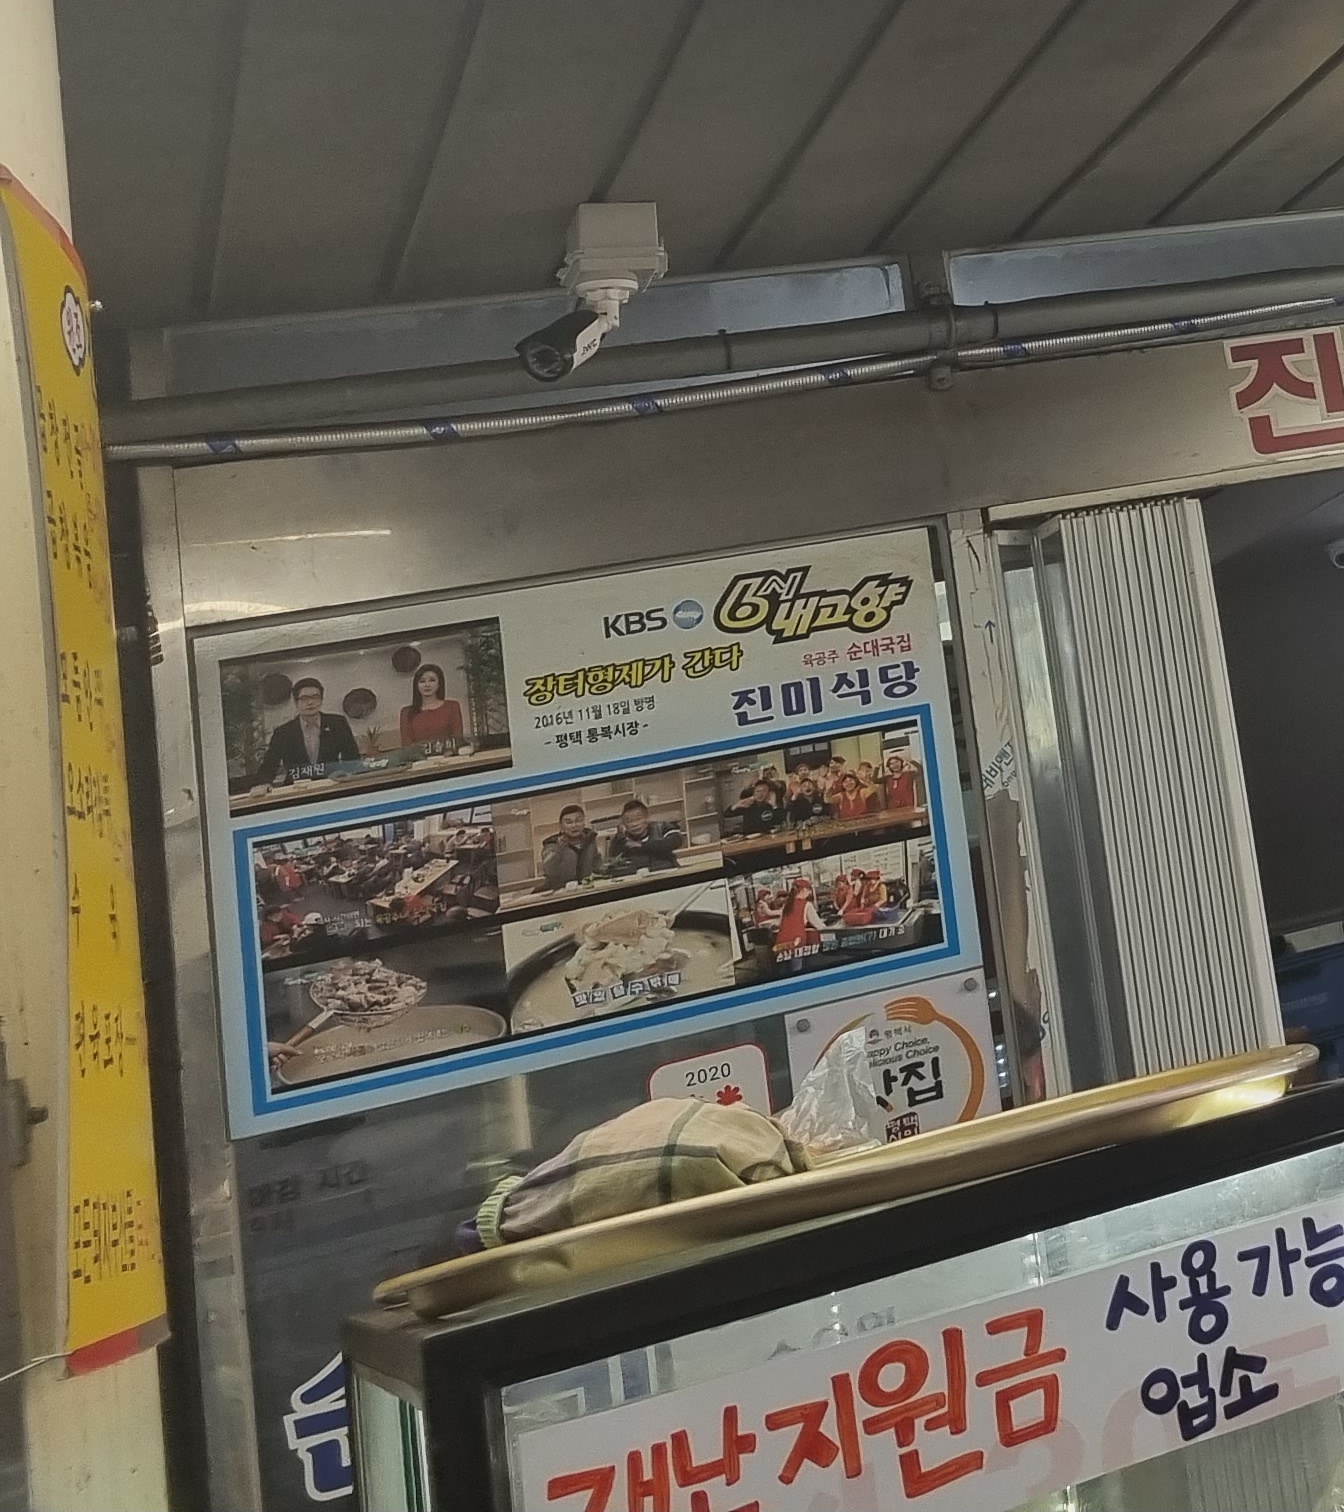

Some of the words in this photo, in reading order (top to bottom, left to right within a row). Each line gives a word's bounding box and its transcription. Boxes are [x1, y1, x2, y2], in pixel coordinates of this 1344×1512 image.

[603, 607, 668, 638] KBS
[713, 566, 810, 634] 6시
[768, 573, 914, 644] 내고향
[801, 648, 839, 668] 육공주
[846, 633, 913, 662] 순대국집
[524, 649, 675, 707] 장터형제가
[682, 641, 744, 679] 간다
[731, 660, 921, 728] 진미식당
[534, 708, 574, 730] 2016년
[577, 703, 602, 724] 11월
[606, 698, 632, 717] 18일
[554, 728, 583, 750] 평택
[585, 721, 640, 746] 통복시장
[288, 762, 325, 780] 김재원
[866, 1044, 892, 1059] appy
[905, 1044, 941, 1060] Choice
[685, 1062, 732, 1088] 2020
[1140, 1346, 1280, 1440] 업소
